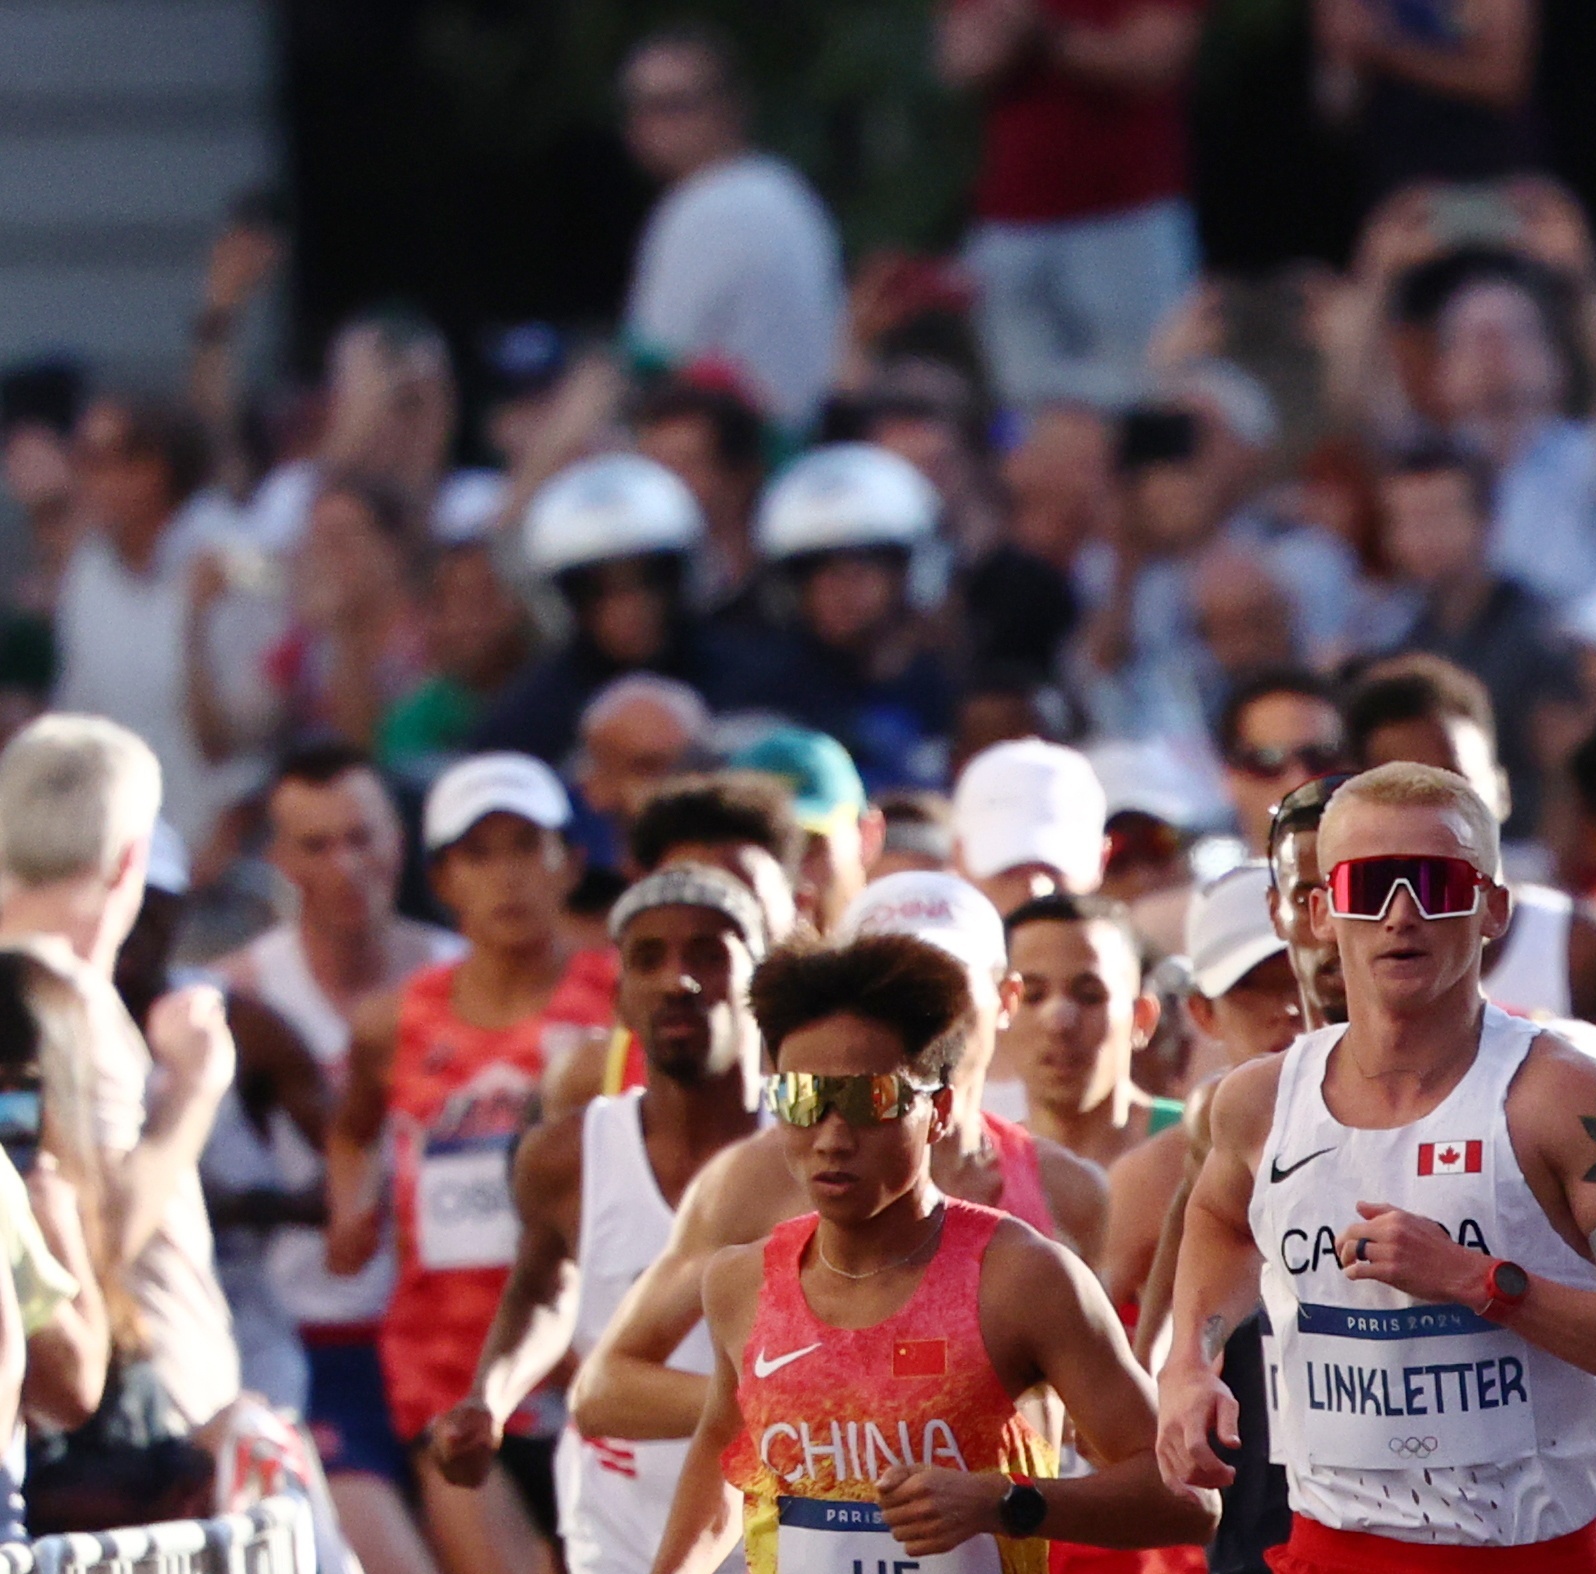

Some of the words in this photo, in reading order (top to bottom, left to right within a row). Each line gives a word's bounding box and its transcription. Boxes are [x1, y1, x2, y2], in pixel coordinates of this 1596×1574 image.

[1281, 1218, 1491, 1275] CAA
[1347, 1316, 1400, 1332] PARIS
[1406, 1313, 1462, 1330] 2024
[1306, 1355, 1528, 1417] LINKLETTER
[760, 1418, 968, 1484] CHINA
[826, 1508, 884, 1524] PARIS
